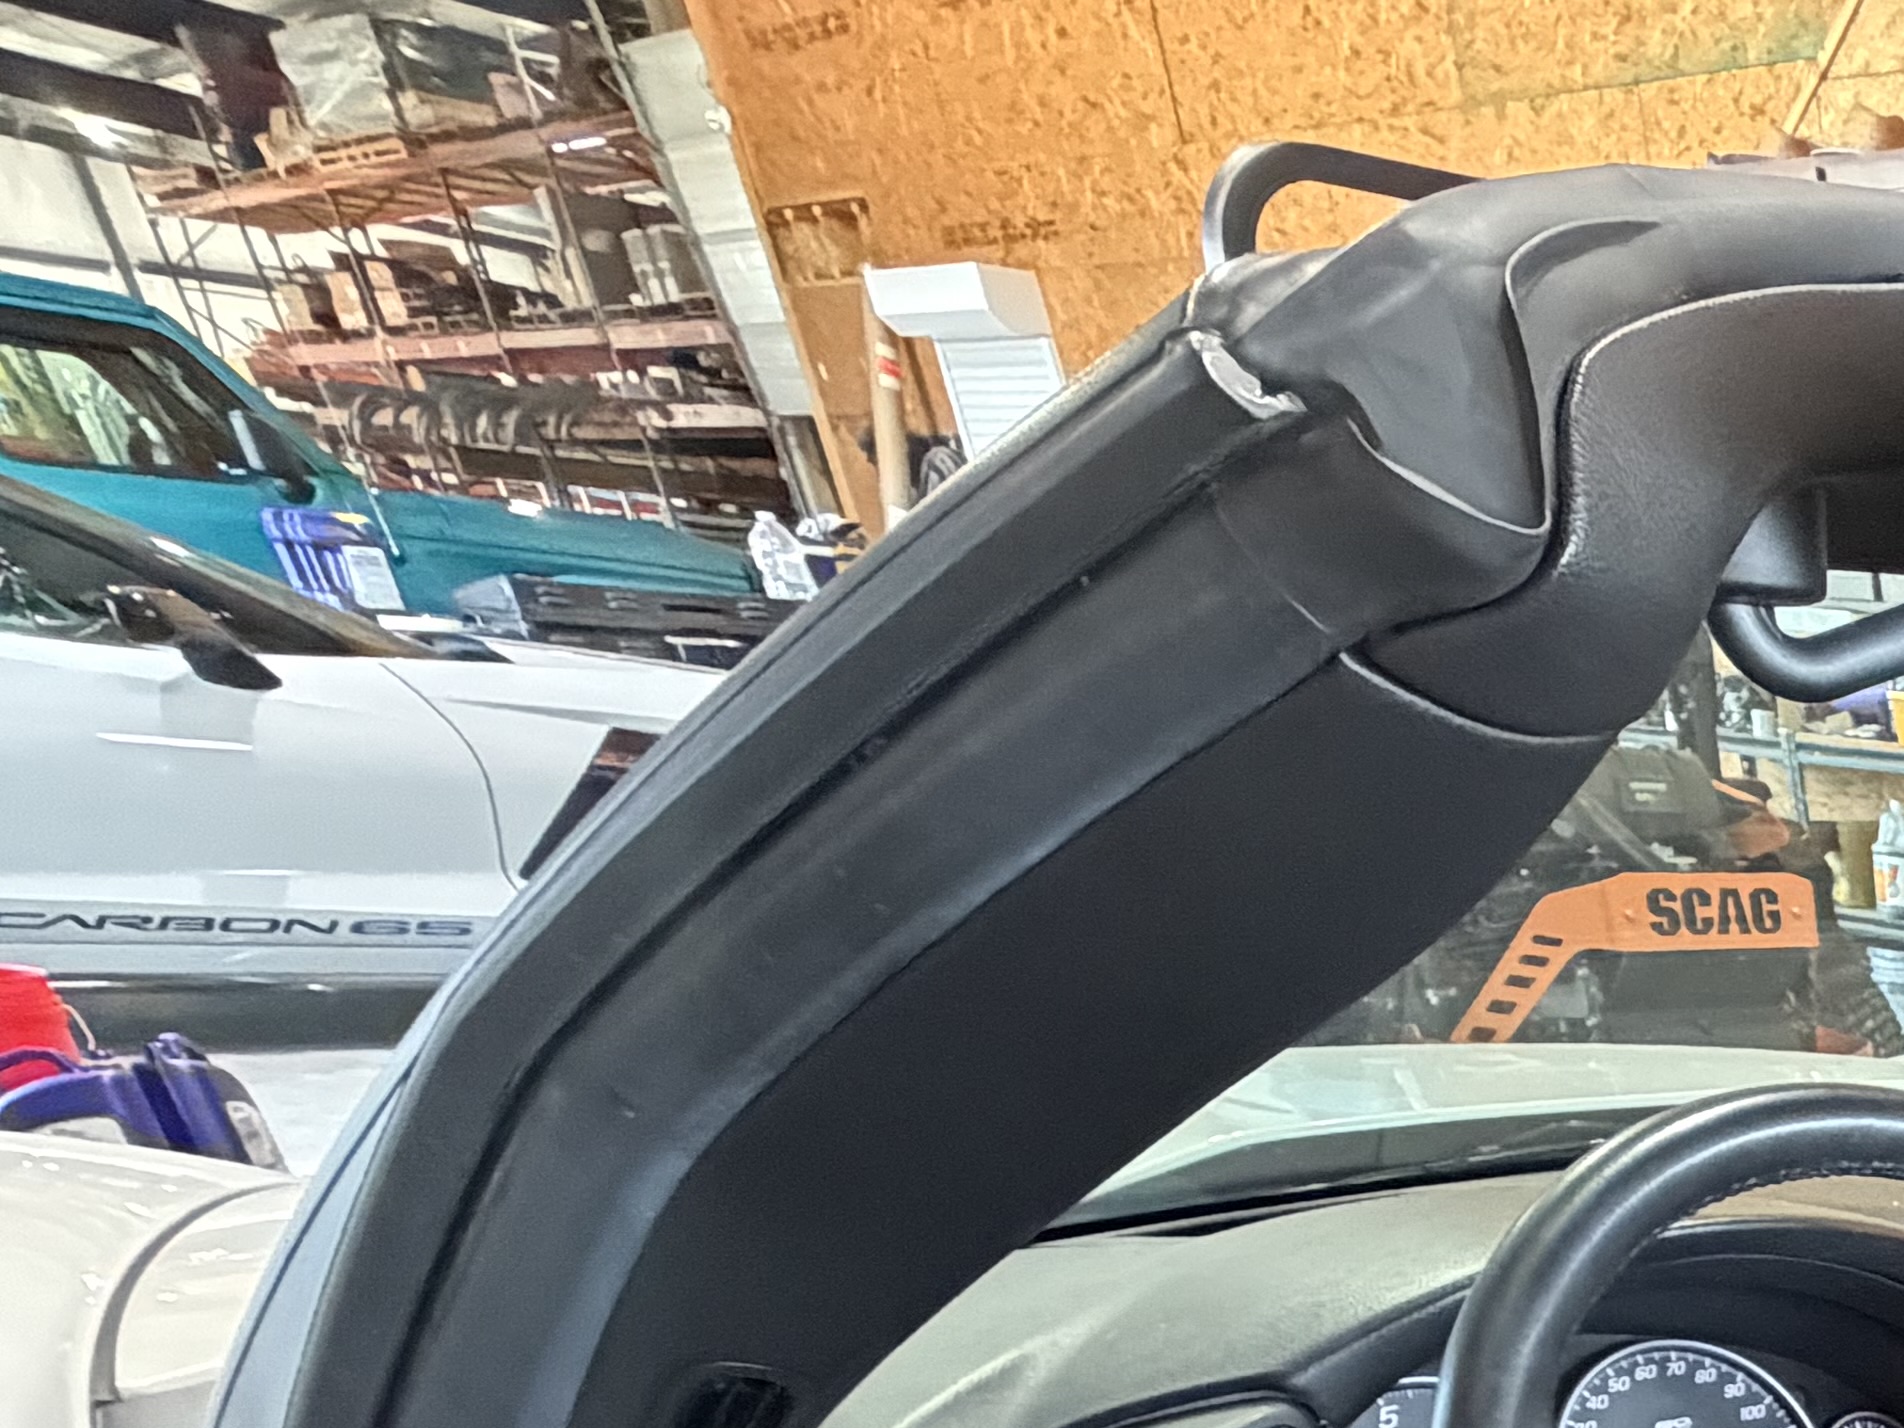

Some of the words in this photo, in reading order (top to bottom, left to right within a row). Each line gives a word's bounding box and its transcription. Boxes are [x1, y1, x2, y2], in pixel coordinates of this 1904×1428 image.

[1646, 887, 1782, 936] SCAG
[0, 912, 339, 935] CARBON
[1634, 1364, 1657, 1382] 60
[1666, 1360, 1687, 1377] 70
[1694, 1367, 1718, 1384] 80
[1607, 1376, 1631, 1394] 50
[1723, 1382, 1746, 1399] 90
[1585, 1394, 1610, 1411] 40
[1740, 1403, 1767, 1421] 100
